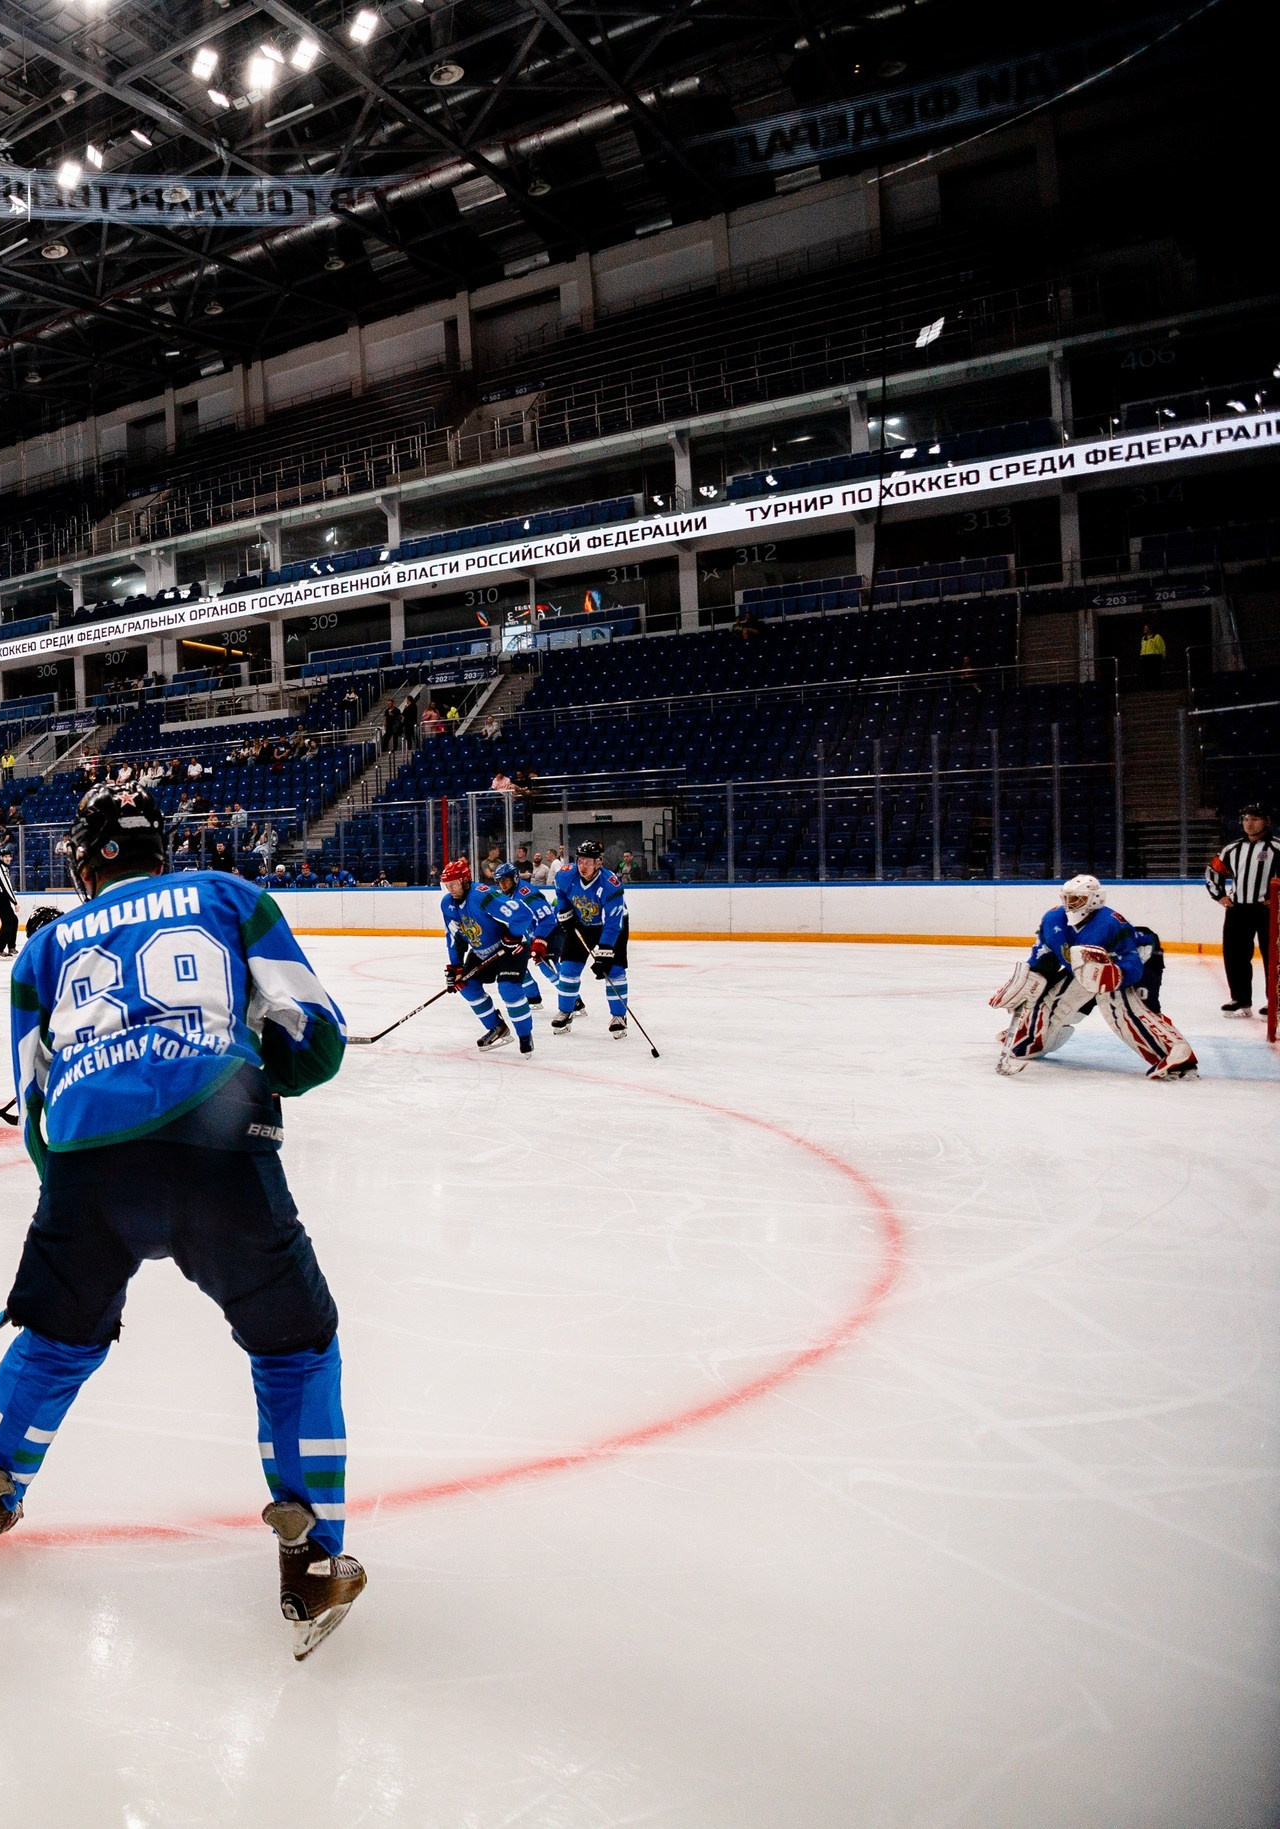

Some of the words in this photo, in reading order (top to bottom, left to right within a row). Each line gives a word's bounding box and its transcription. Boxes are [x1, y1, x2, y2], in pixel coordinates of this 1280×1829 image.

[746, 494, 833, 522] ТУРНИР
[842, 487, 873, 505] ПО
[880, 469, 980, 500] ХОККЕЮ
[989, 453, 1075, 482] СРЕДИ
[963, 508, 1012, 533] 313
[736, 544, 778, 566] 312
[39, 633, 75, 651] СРЕДИ
[189, 601, 246, 621] ОРГАНОВ
[251, 570, 391, 609] ГОСУДАРСТВЕННОЙ
[396, 560, 459, 584] ВЛАСТИ
[465, 537, 580, 572] РОССИЙСКОЙ
[587, 516, 708, 550] ФЕДЕРАЦИИ
[606, 564, 643, 586] 311
[464, 587, 499, 607] 310
[1105, 596, 1127, 606] 203
[1155, 590, 1177, 601] 204
[309, 613, 338, 631] 309
[221, 630, 248, 645] 308
[104, 650, 128, 666] 307
[36, 663, 58, 679] 306
[434, 675, 448, 683] 202
[463, 672, 477, 680] 203
[55, 886, 201, 950] МИШИН
[499, 900, 520, 918] 80
[535, 905, 552, 919] 50
[48, 925, 236, 1053] 69
[1138, 1014, 1174, 1045] CCM
